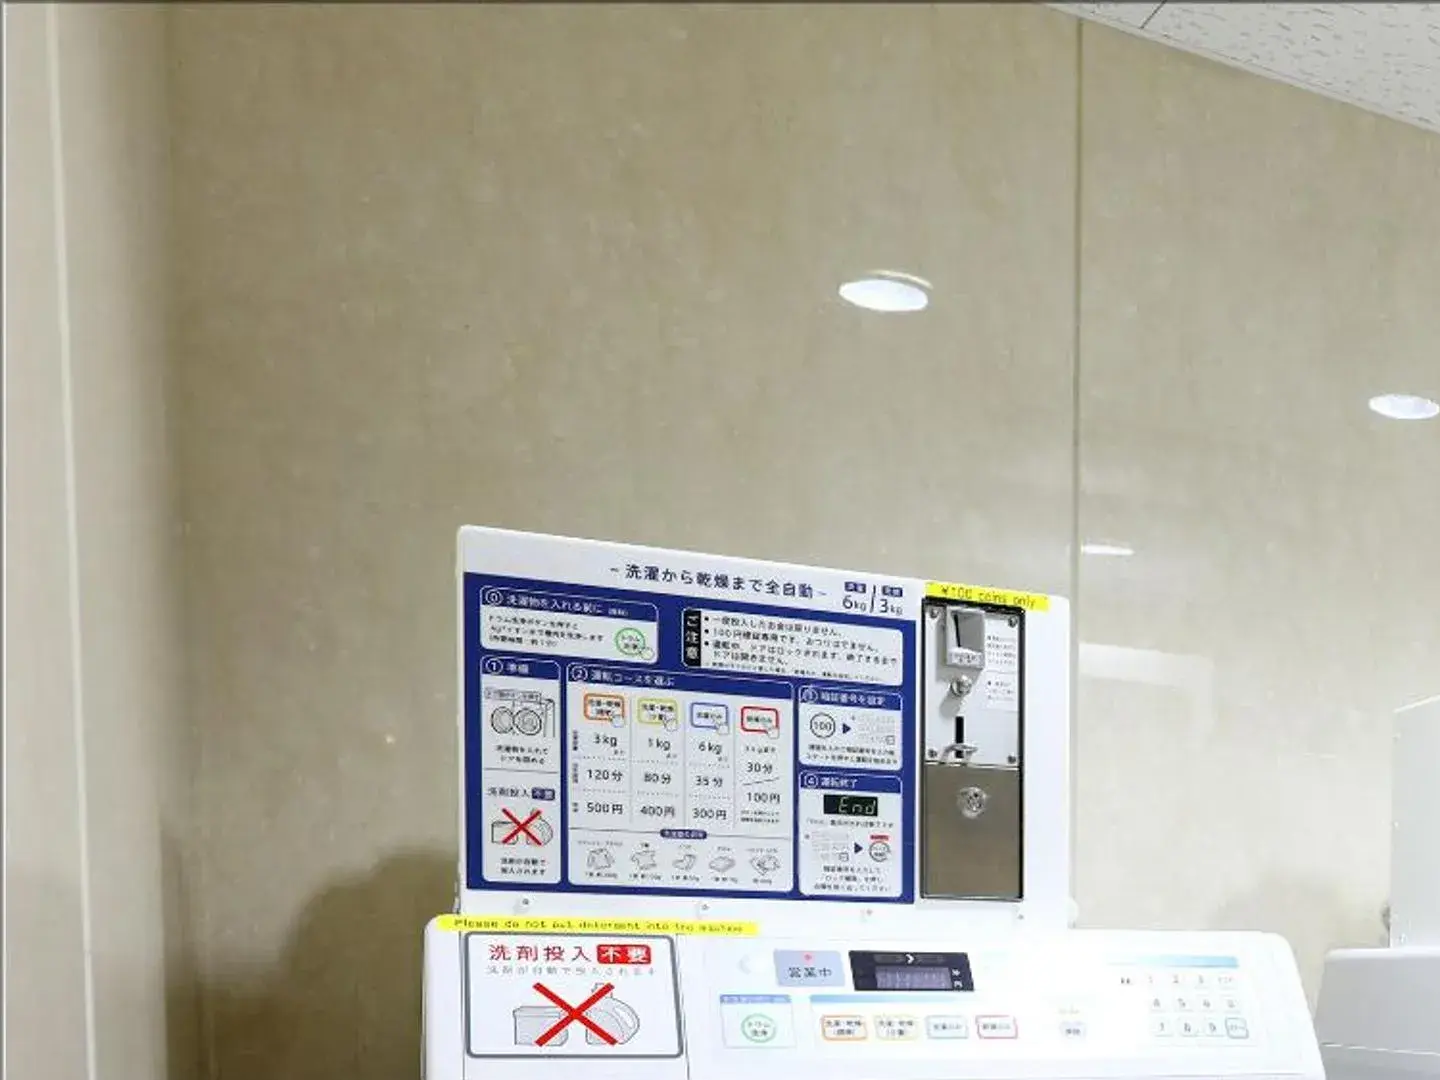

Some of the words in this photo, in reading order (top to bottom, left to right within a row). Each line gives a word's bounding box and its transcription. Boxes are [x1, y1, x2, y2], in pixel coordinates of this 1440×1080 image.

[625, 564, 813, 598] 洗濯から乾燥まで全自動
[489, 944, 591, 962] 洗剤投入
